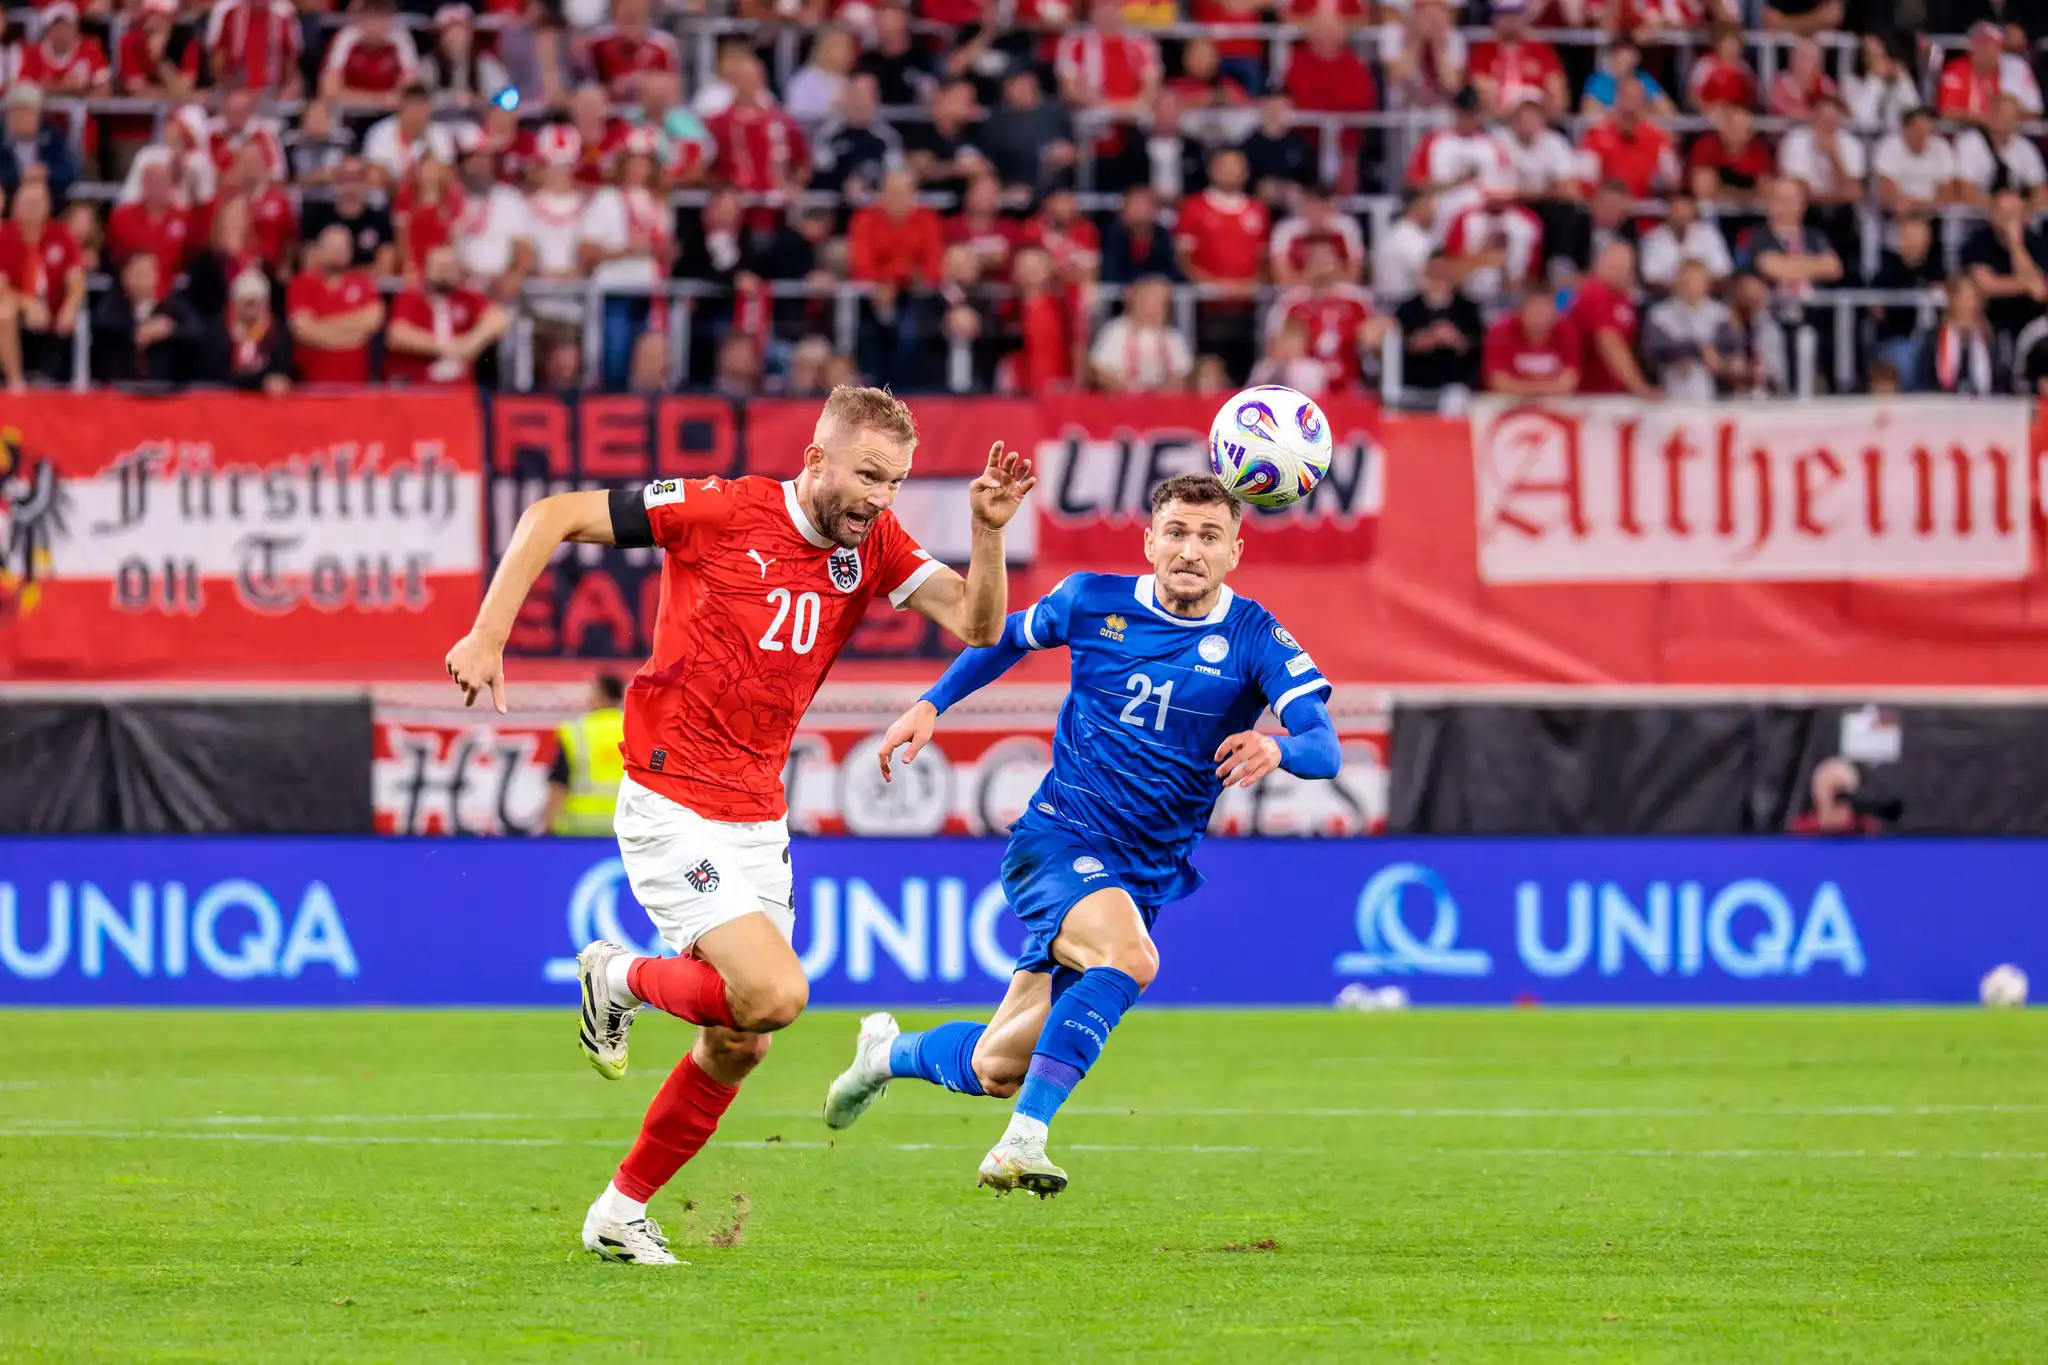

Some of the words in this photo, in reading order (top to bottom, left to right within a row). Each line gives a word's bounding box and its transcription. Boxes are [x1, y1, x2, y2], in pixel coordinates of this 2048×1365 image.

[493, 395, 736, 478] RED
[1055, 437, 1368, 517] LIEN
[1488, 402, 2016, 562] Altheim
[759, 587, 821, 655] 20
[1119, 673, 1174, 731] 21
[1194, 664, 1221, 676] CYPRUS
[0, 877, 361, 981] UNIQA
[1513, 876, 1868, 980] UNIQA
